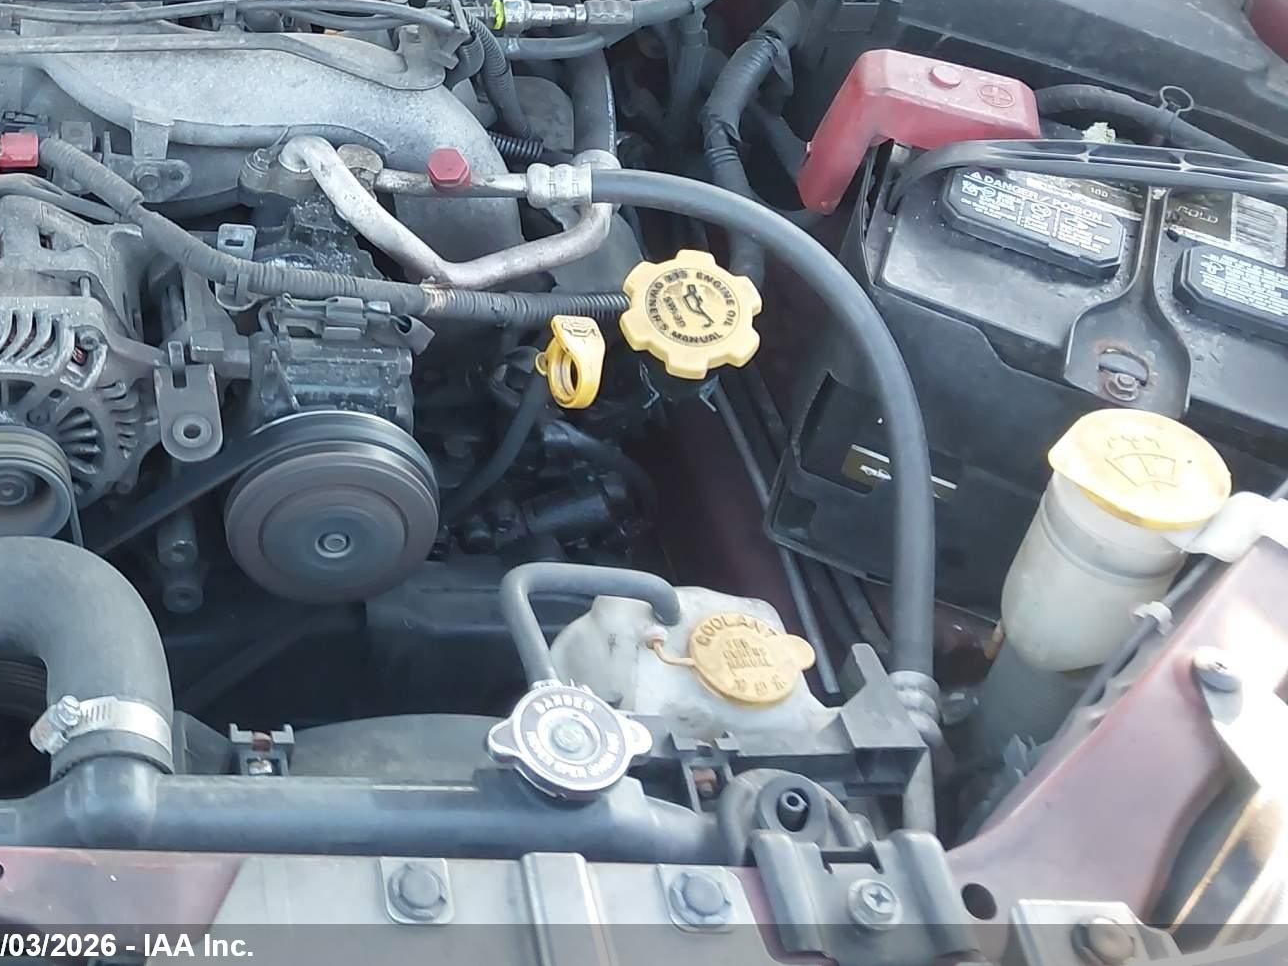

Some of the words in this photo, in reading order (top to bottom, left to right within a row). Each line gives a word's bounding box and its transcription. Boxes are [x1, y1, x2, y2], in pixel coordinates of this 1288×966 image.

[983, 176, 1041, 201] DANGER
[1052, 198, 1104, 222] POISON
[696, 271, 736, 306] ENGINE
[723, 309, 737, 327] OIL
[671, 331, 724, 344] MANUAL
